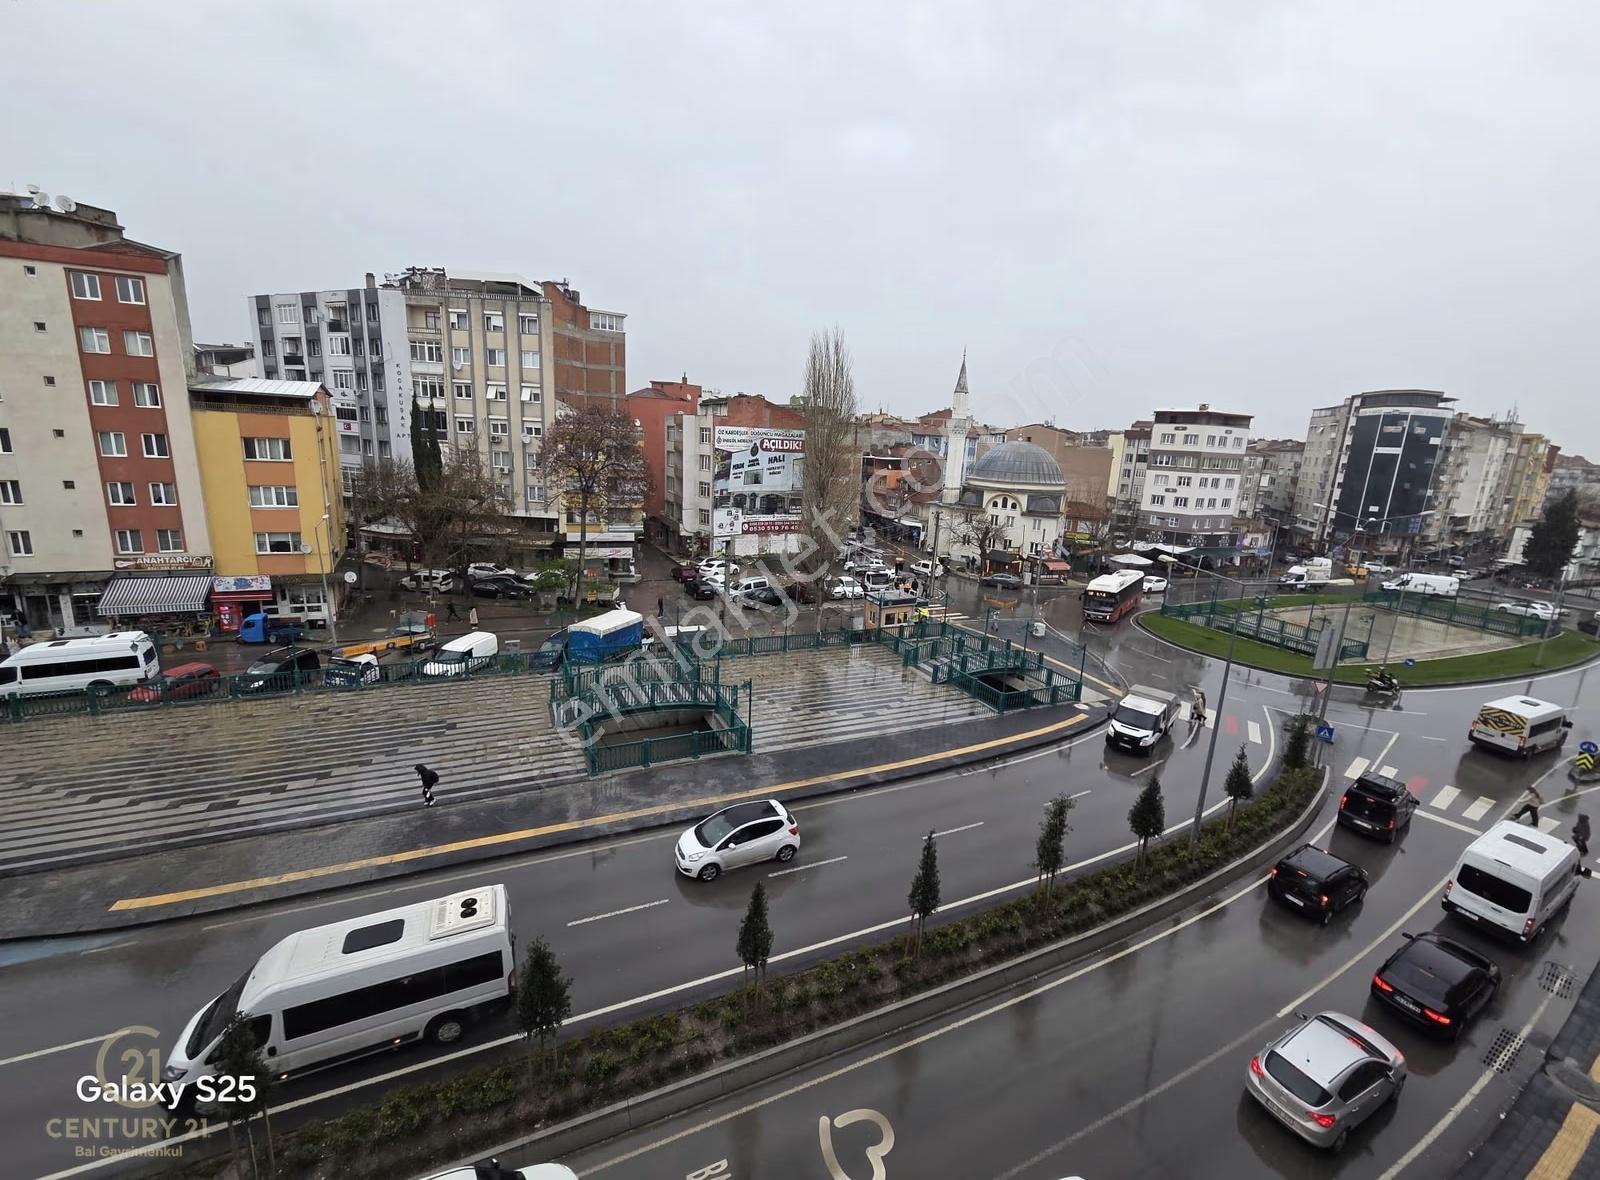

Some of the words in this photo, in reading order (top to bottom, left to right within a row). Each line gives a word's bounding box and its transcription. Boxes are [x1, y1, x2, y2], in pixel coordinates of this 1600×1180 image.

[763, 440, 802, 452] AÇILDIK!
[768, 455, 785, 464] HALI
[136, 556, 192, 564] ANAHTARCI
